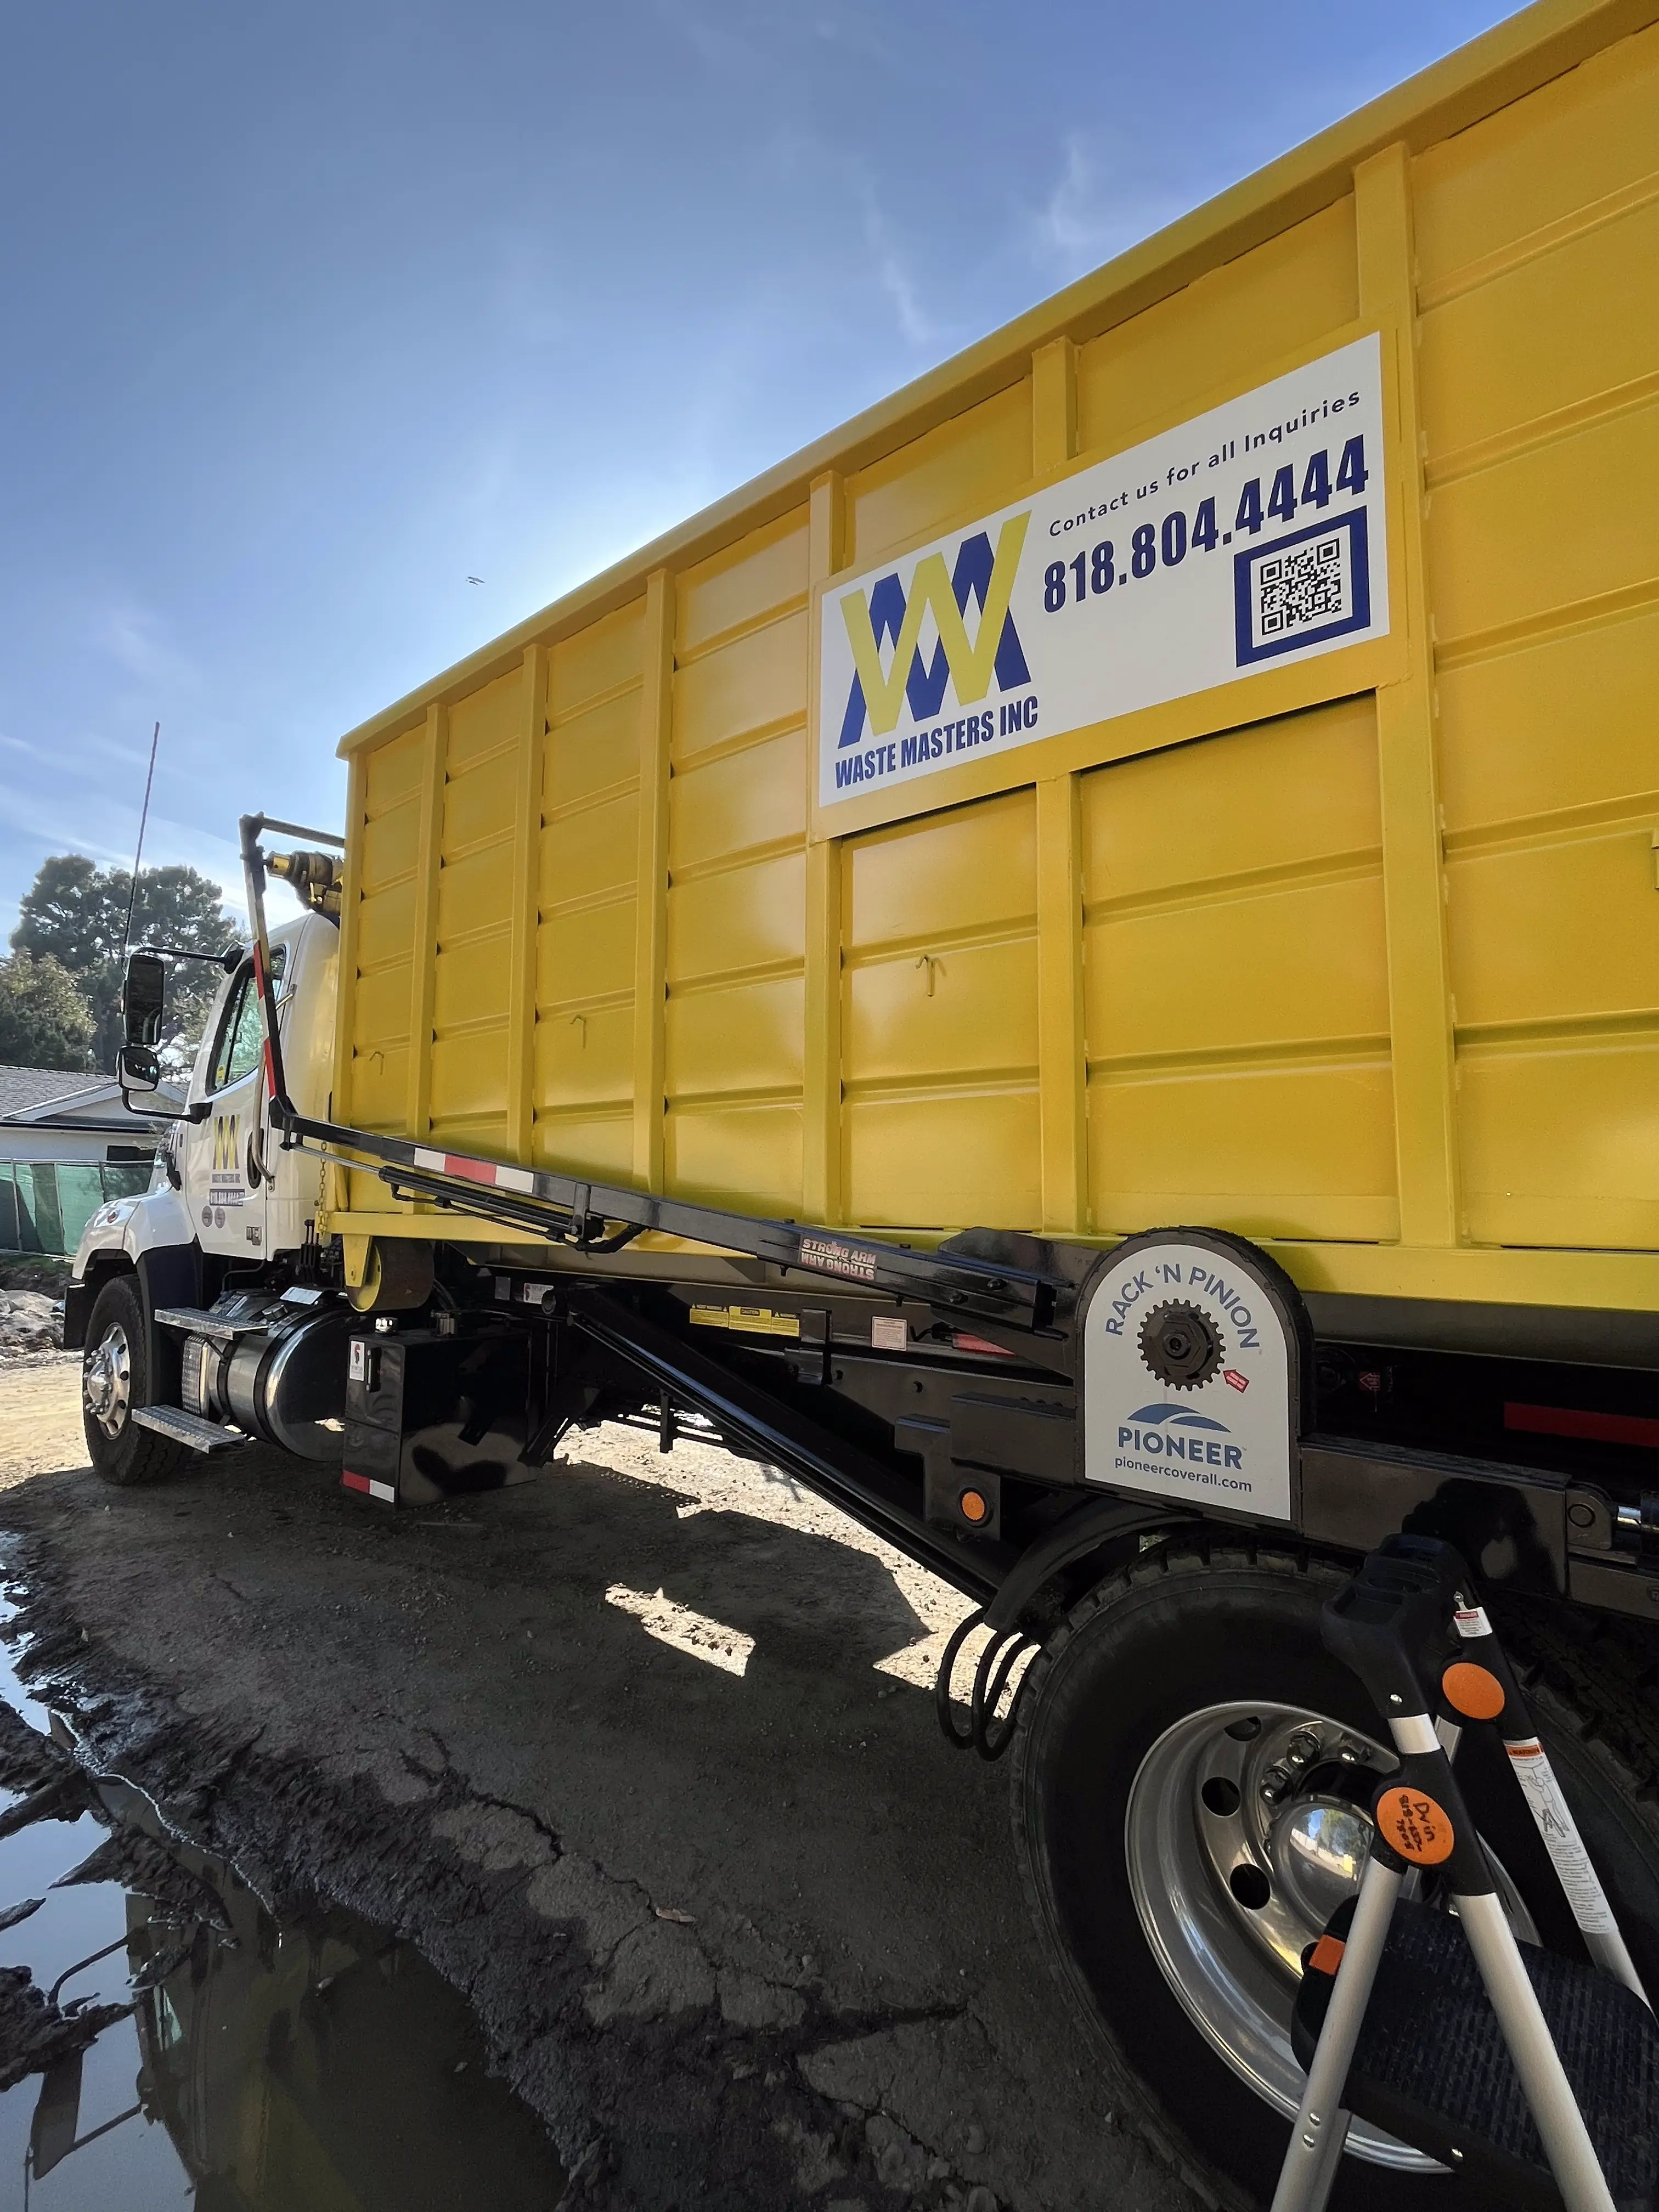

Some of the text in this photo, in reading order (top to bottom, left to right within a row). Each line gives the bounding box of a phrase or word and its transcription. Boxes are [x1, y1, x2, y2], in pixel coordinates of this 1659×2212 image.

[1049, 391, 1359, 537] Contact us for all Inquiries
[1044, 433, 1369, 613] 818.804.4444
[835, 696, 1038, 789] WASTE MASTERS INC
[803, 1238, 877, 1265] STRONG ARM
[1105, 1270, 1154, 1336] RACK
[1188, 1266, 1260, 1348] PINION
[1115, 1456, 1252, 1492] pioneercoverall.com
[1118, 1426, 1242, 1470] PIONEER
